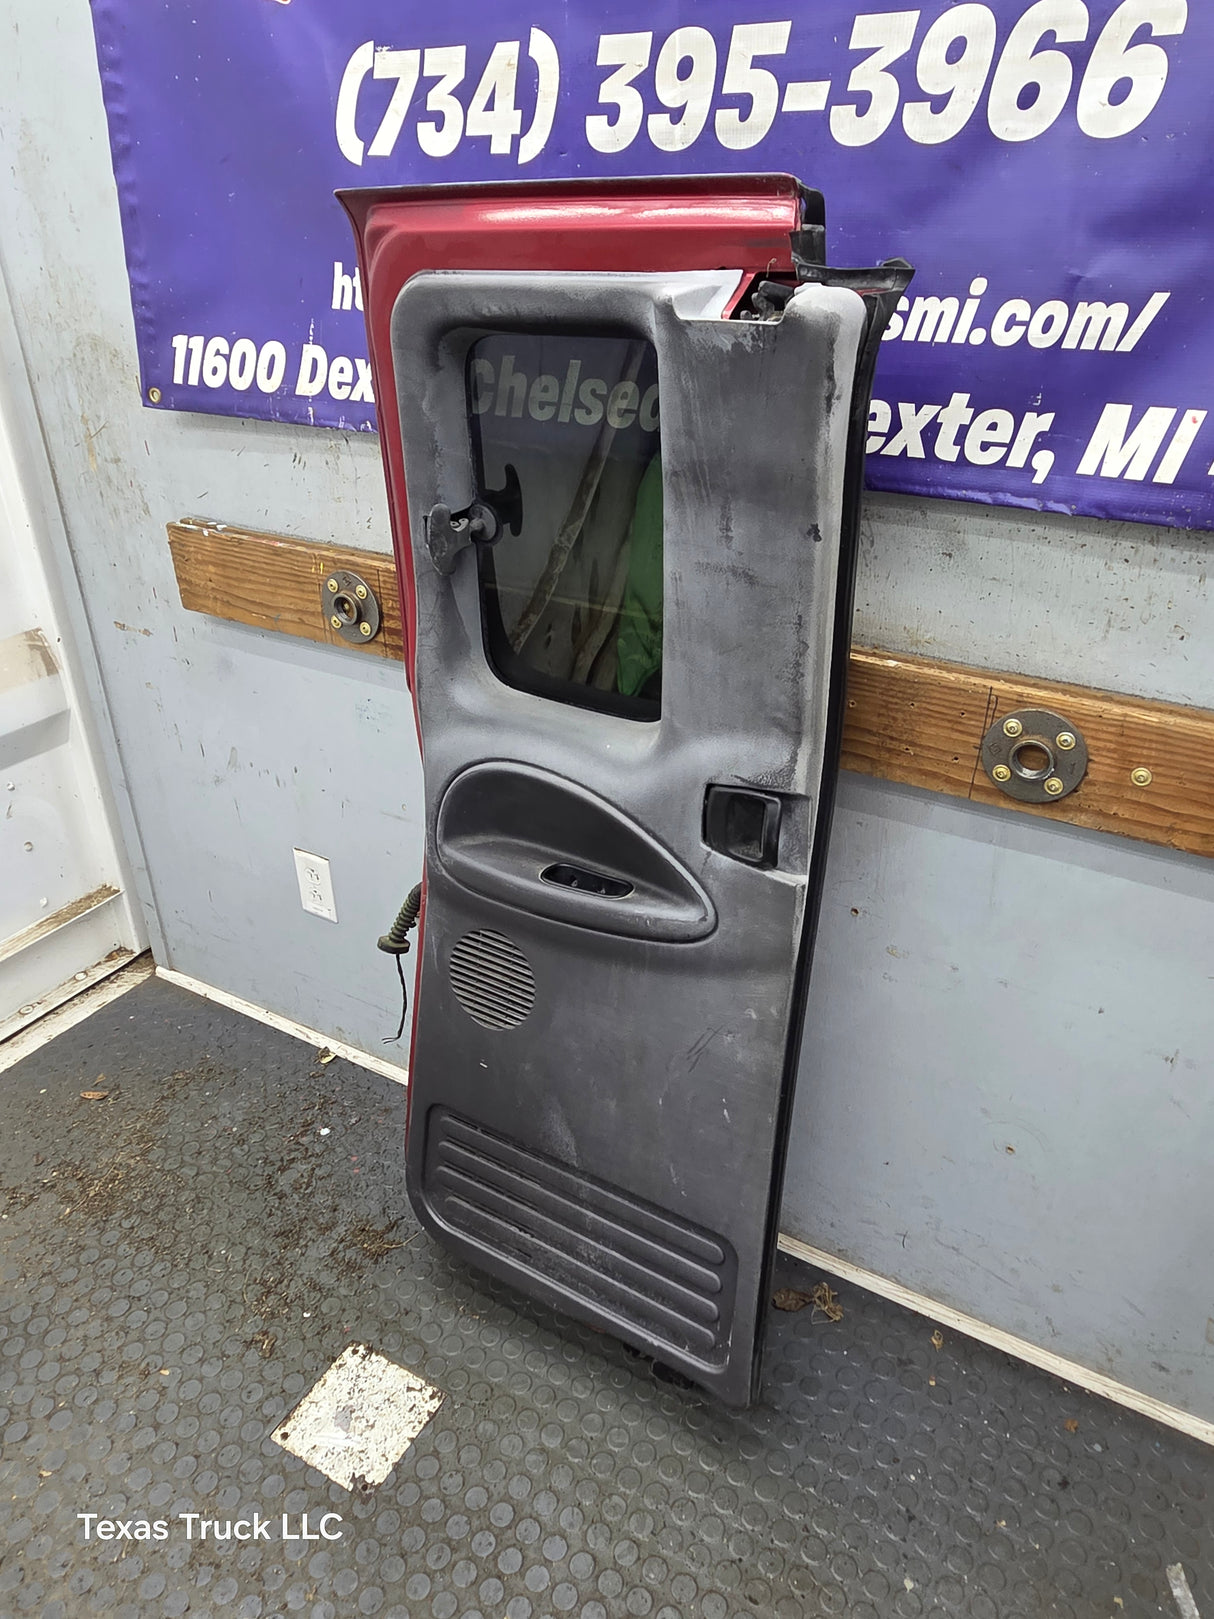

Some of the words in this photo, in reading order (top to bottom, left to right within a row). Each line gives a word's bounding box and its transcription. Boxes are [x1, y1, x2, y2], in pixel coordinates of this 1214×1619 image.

[335, 27, 560, 166] (734)
[585, 0, 1188, 153] 395-3966
[172, 335, 286, 394] 11600
[295, 342, 375, 403] Dex
[1076, 403, 1208, 484] MI
